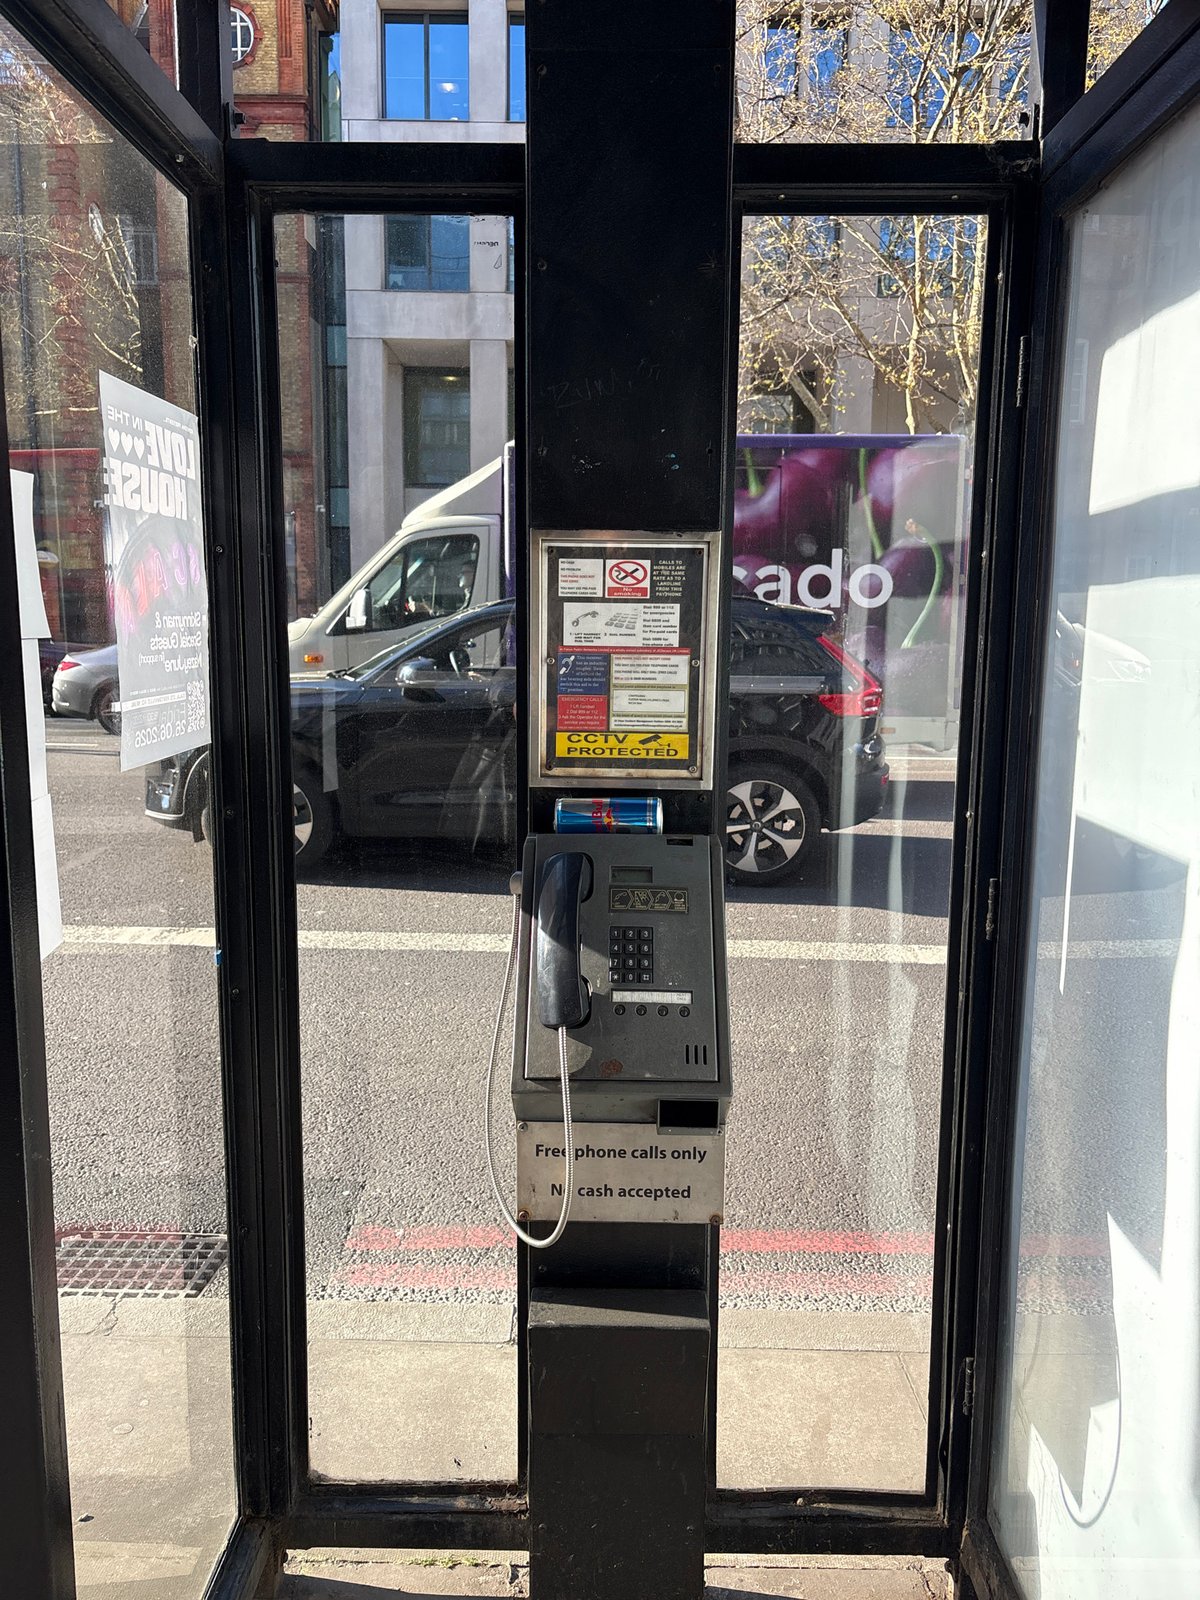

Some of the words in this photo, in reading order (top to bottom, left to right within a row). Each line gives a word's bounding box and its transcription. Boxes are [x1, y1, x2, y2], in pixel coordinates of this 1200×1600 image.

[567, 733, 629, 744] CCTV
[567, 746, 679, 757] PROTECTED
[535, 1144, 567, 1158] Free
[574, 1144, 627, 1161] phone
[631, 1146, 667, 1160] calls
[671, 1146, 707, 1163] only
[577, 1184, 614, 1197] cash
[617, 1185, 691, 1201] accepted
